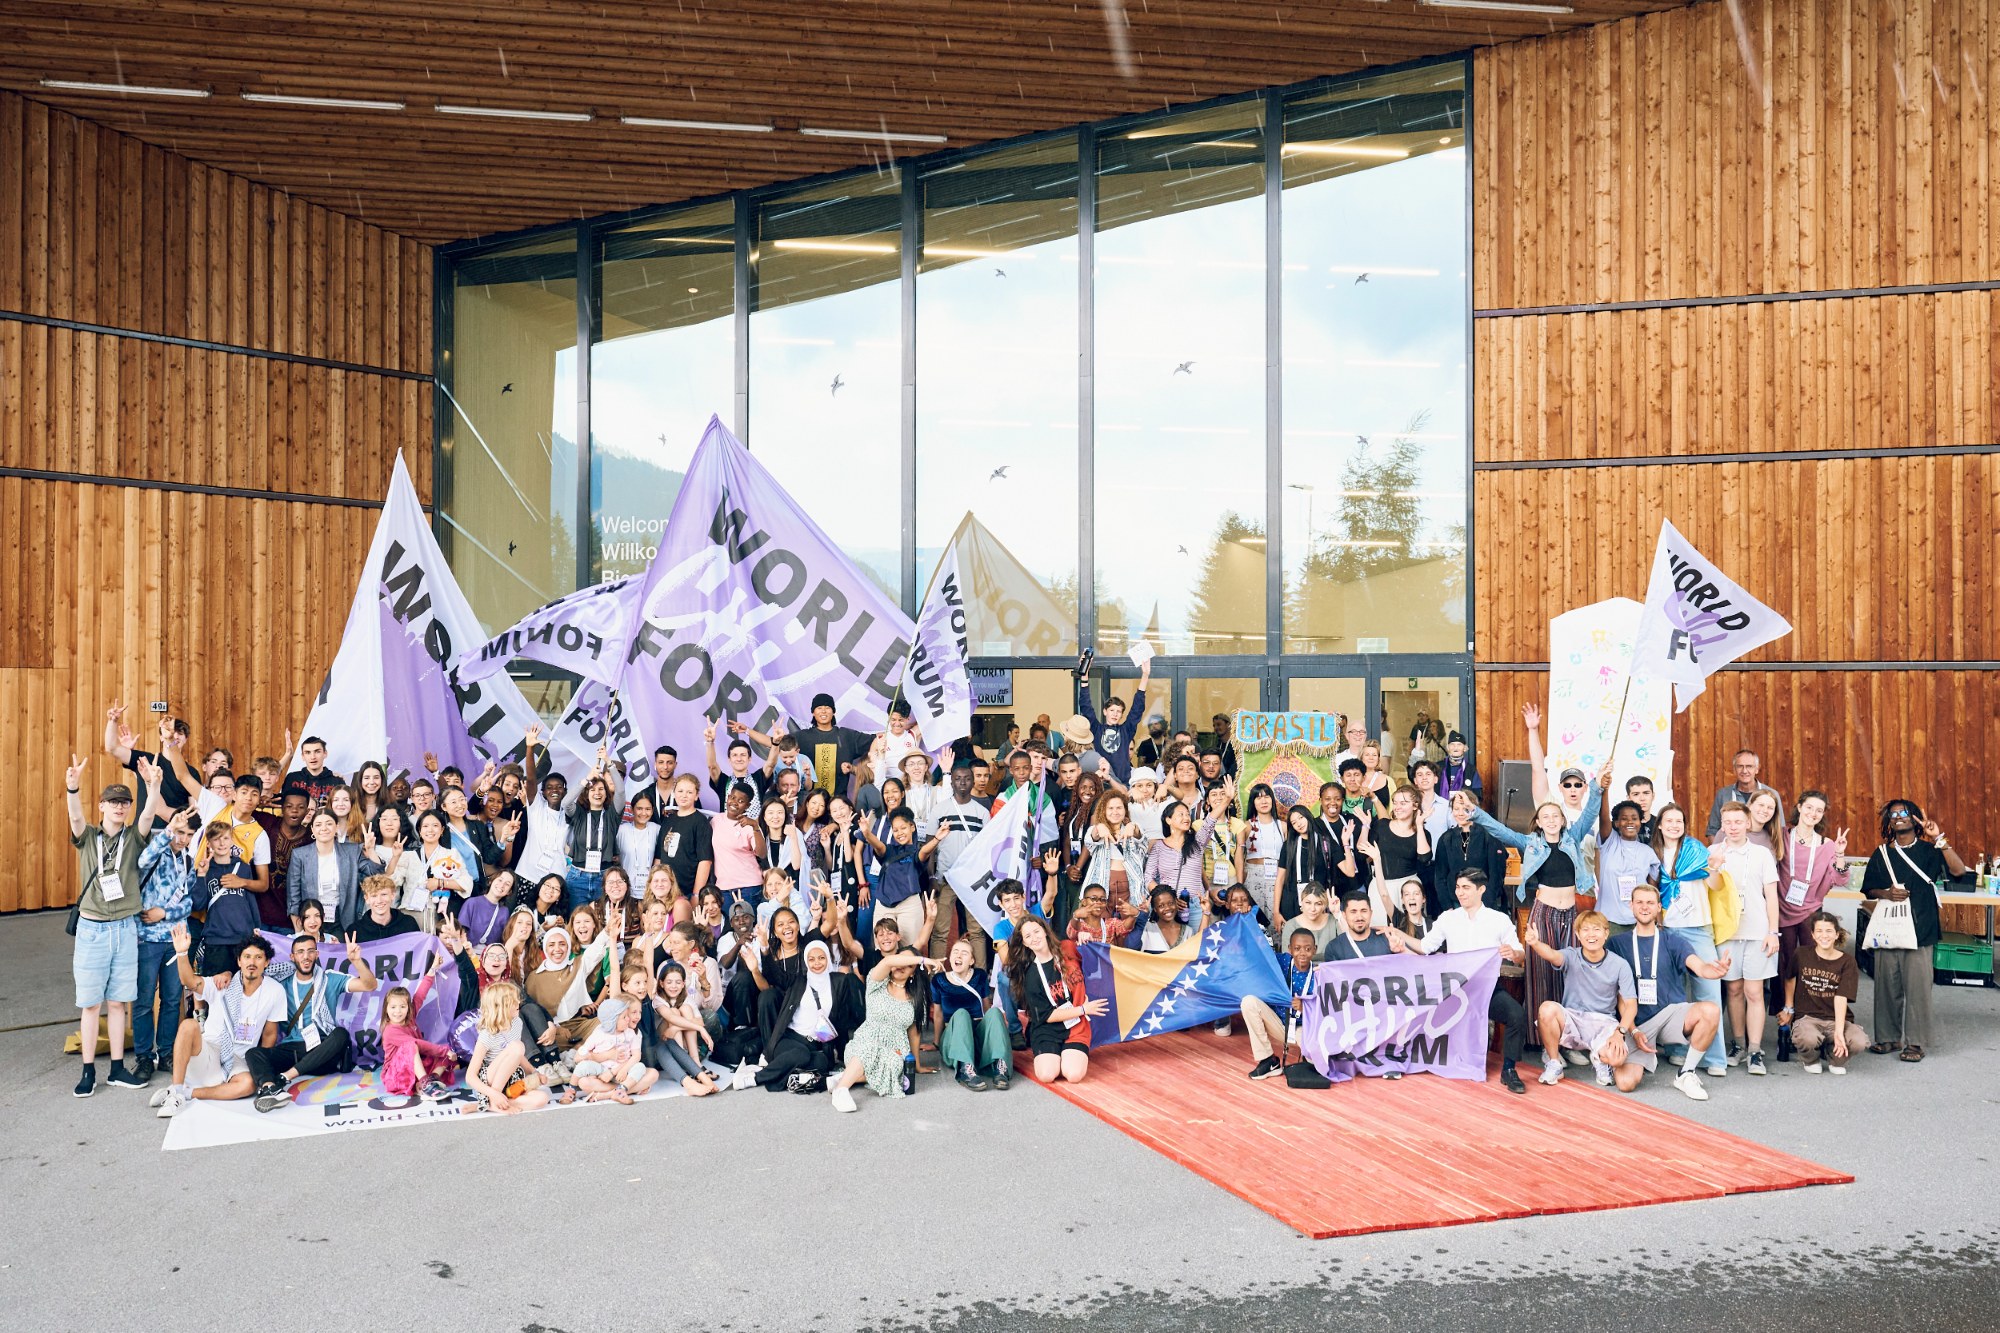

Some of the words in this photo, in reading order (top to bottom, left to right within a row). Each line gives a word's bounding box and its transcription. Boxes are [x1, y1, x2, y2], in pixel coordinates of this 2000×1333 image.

[601, 515, 669, 533] Welco
[601, 543, 658, 561] Willko
[708, 485, 912, 701] WORLD
[627, 620, 801, 761] FORU
[909, 632, 945, 718] RUM
[977, 694, 1005, 703] ORUM
[608, 689, 651, 783] ORLD
[1241, 714, 1332, 742] BRASIL
[1318, 972, 1468, 1017] WORLD
[324, 1106, 461, 1128] world-chil
